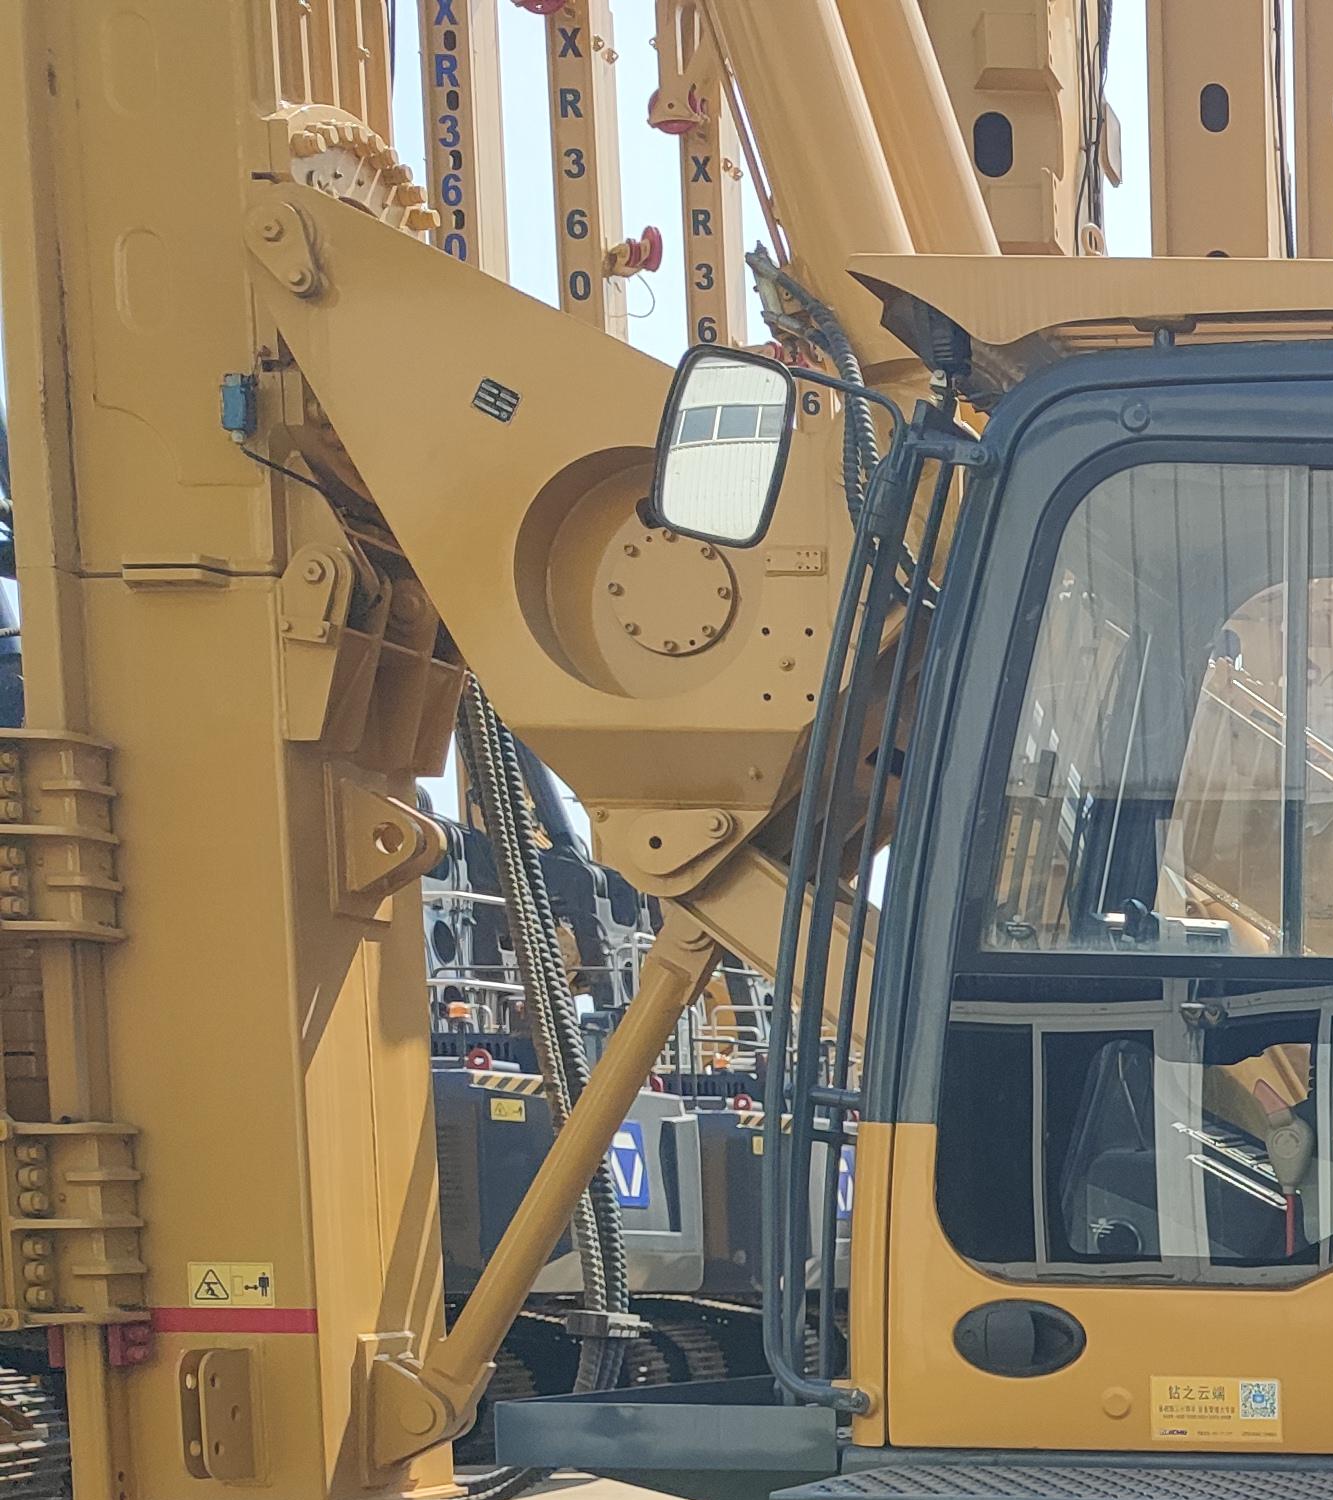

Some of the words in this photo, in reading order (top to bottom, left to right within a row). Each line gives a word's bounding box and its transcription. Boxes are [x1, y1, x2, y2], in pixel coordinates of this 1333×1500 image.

[558, 27, 591, 301] XR360
[1168, 1385, 1225, 1402] 钻之云端
